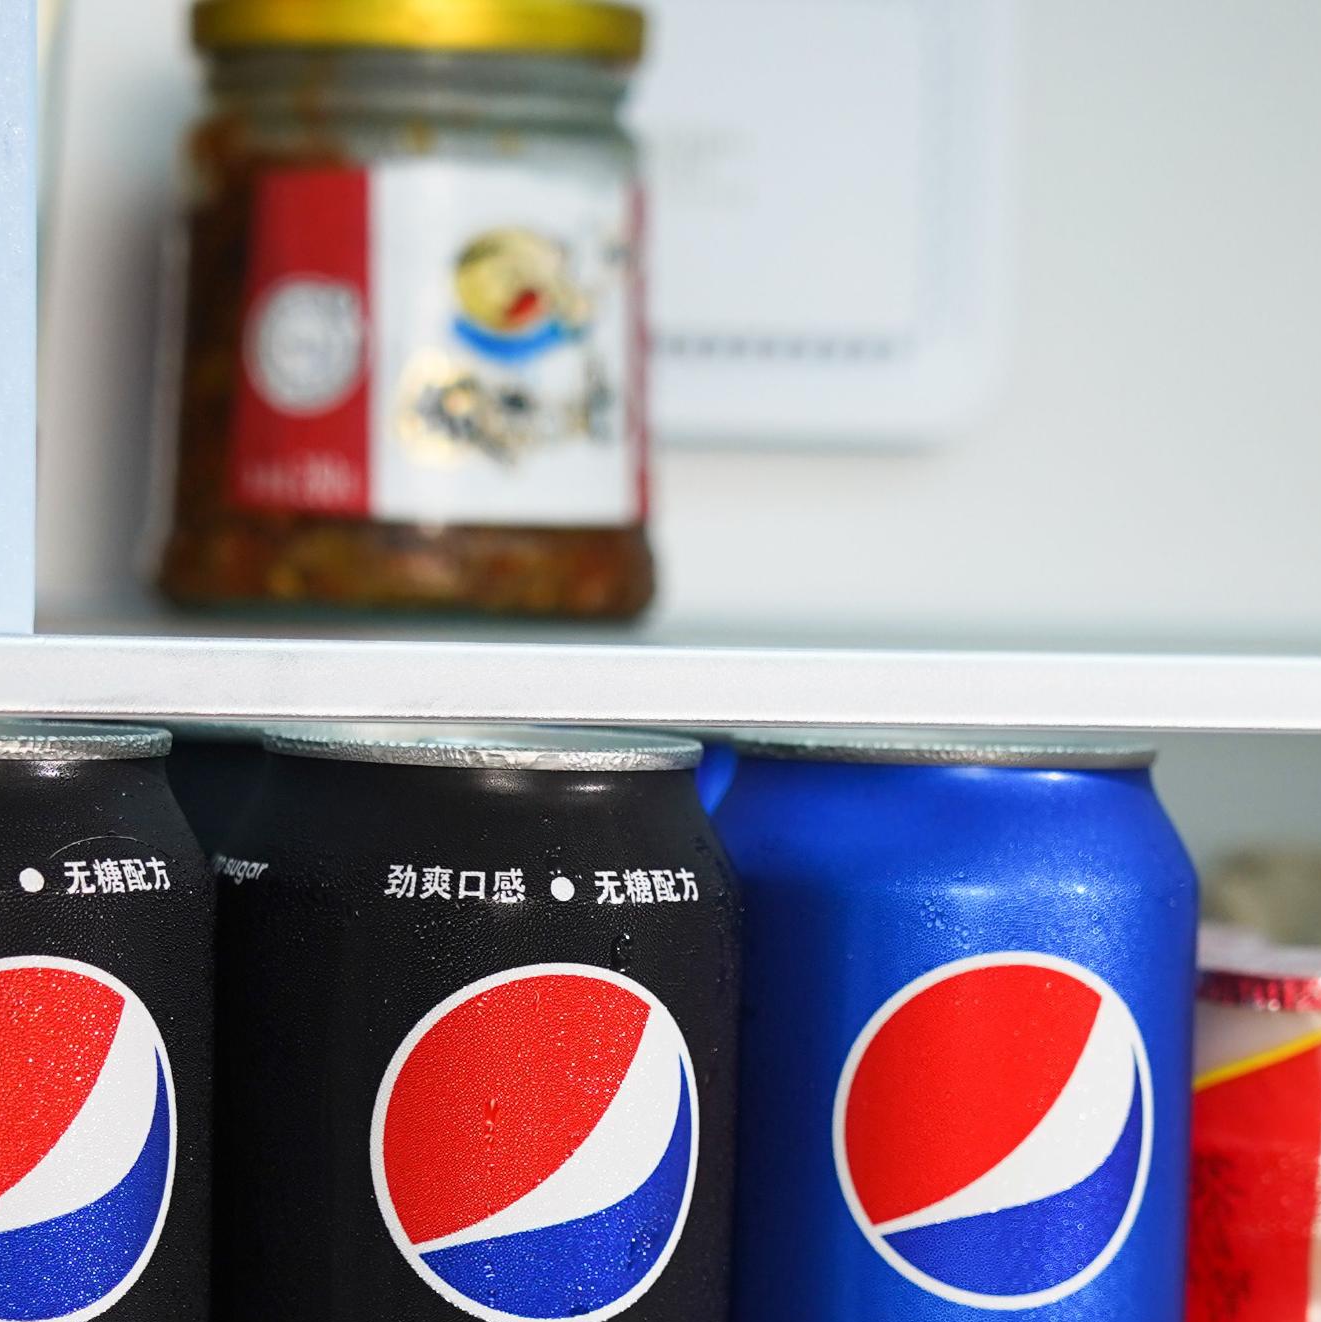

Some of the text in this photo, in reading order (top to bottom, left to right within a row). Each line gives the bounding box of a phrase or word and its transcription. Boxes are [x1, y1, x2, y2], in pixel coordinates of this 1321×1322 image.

[64, 856, 172, 894] 无糖配方
[223, 857, 269, 886] sugar
[384, 864, 700, 905] 劲爽口感 无糖配方
